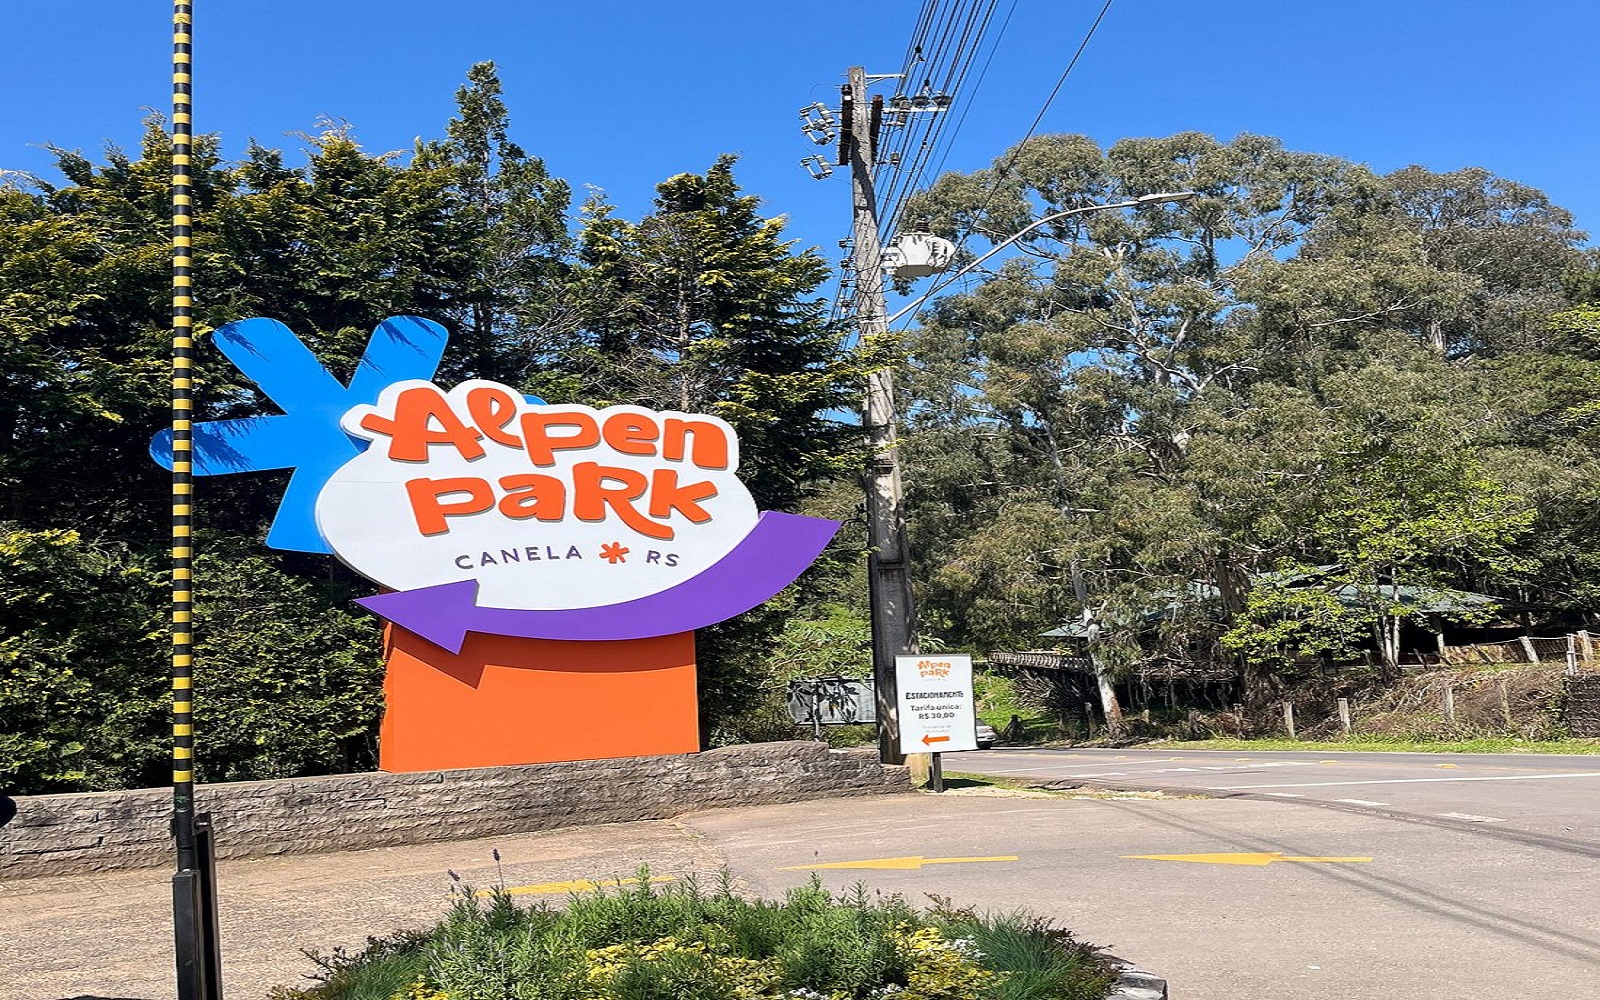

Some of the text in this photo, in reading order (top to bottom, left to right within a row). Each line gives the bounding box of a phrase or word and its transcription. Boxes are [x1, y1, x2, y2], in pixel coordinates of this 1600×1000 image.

[361, 387, 728, 470] Alpen
[455, 547, 680, 570] CANELA RS
